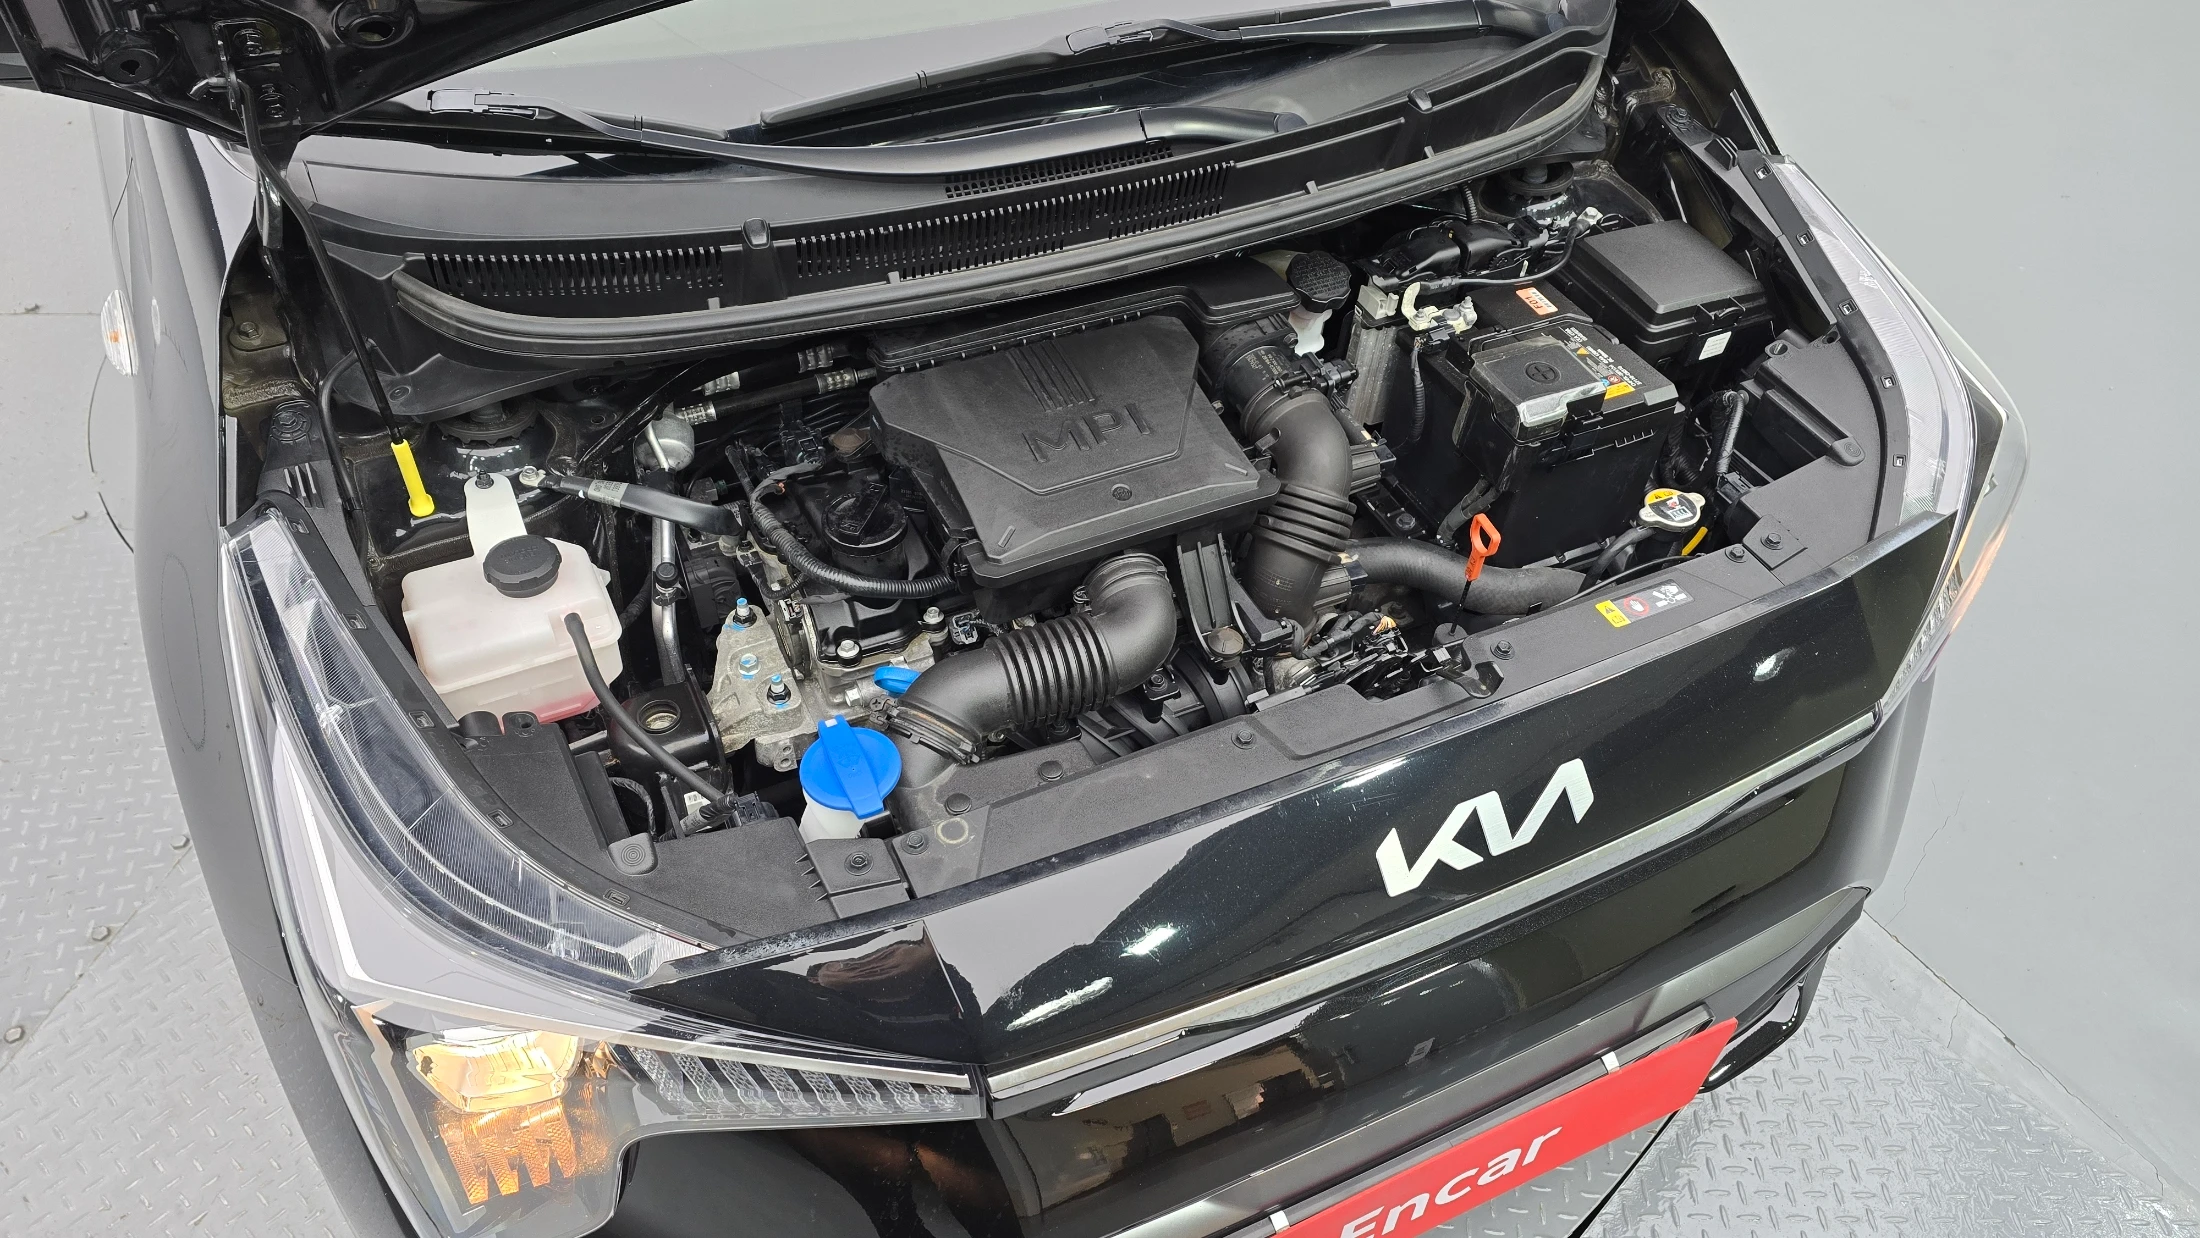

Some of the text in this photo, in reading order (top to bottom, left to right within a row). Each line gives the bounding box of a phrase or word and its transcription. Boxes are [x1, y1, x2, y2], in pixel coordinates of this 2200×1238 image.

[1022, 402, 1152, 464] MPI
[1376, 758, 1594, 897] KIA
[1339, 1126, 1563, 1238] Encar
